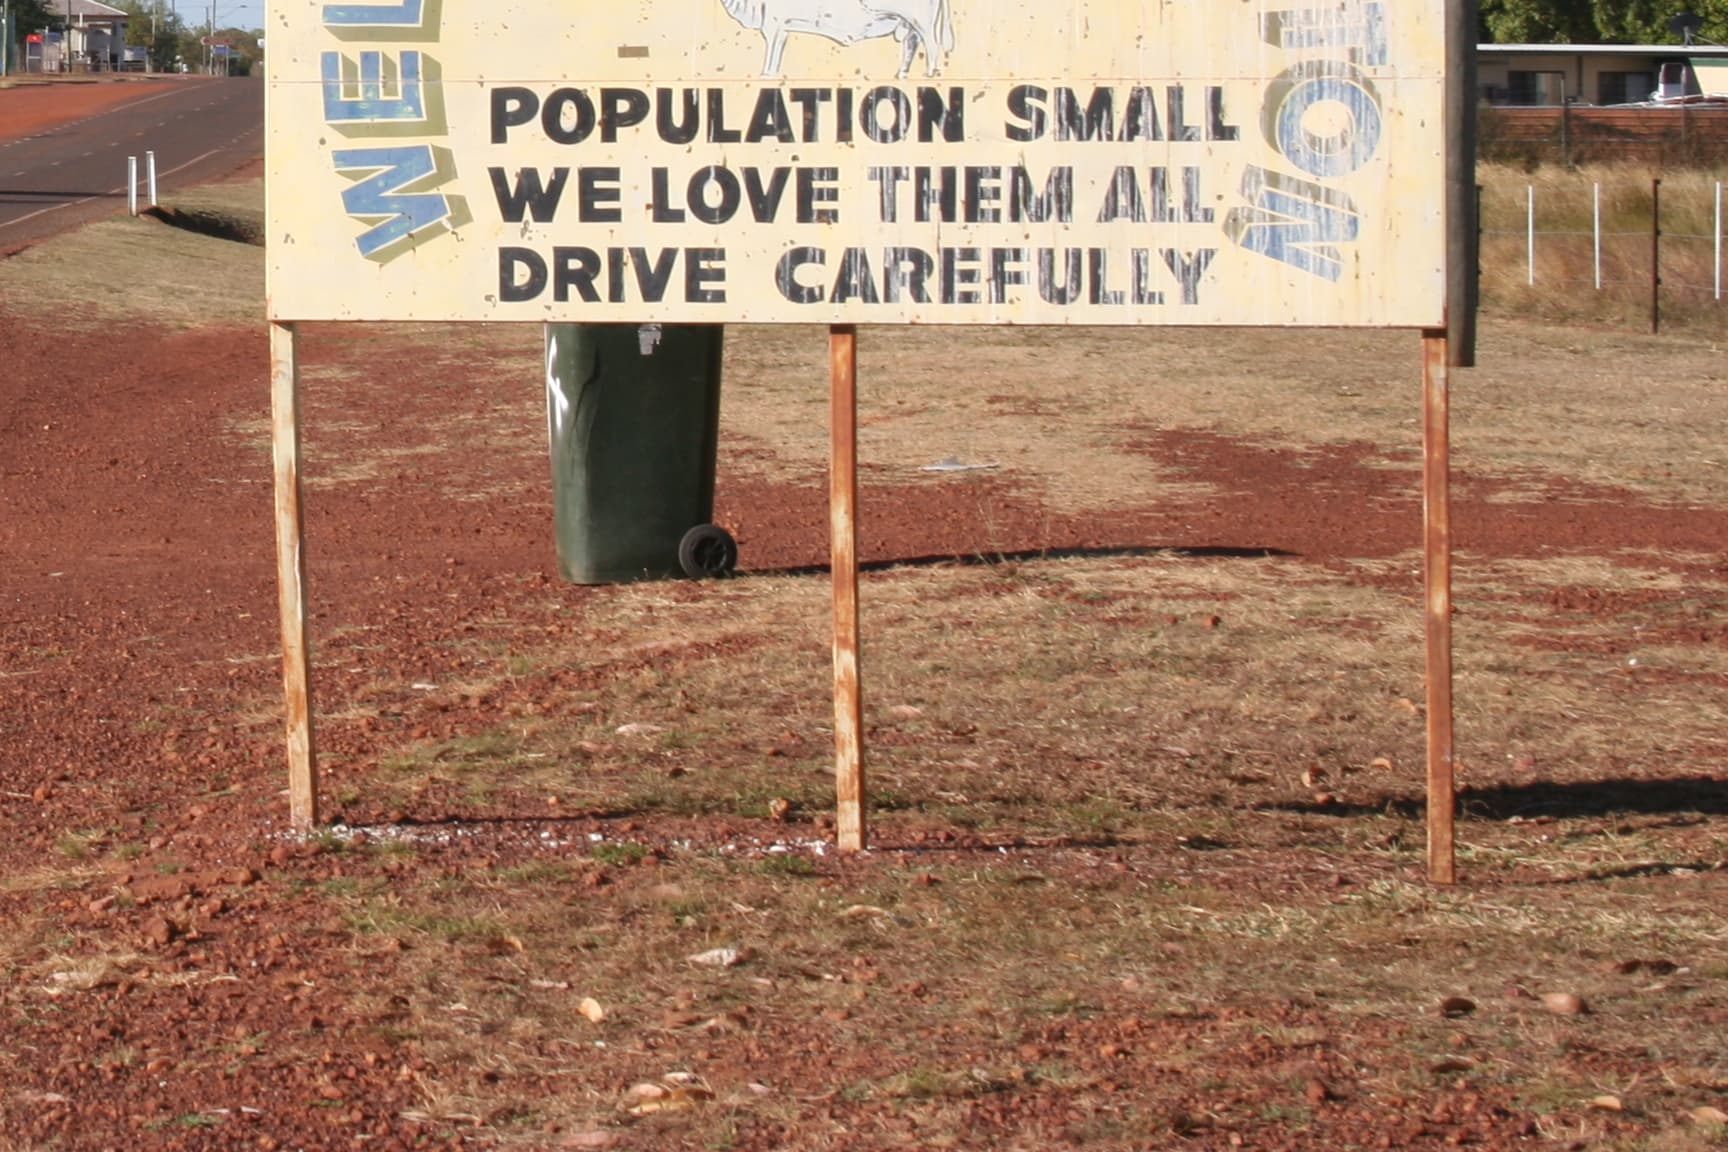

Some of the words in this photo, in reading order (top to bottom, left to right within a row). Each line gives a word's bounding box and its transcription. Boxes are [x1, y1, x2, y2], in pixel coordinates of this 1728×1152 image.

[490, 86, 965, 145] POPULATION
[1004, 85, 1240, 144] SMALL
[488, 166, 622, 224] WE
[651, 165, 840, 225] LOVE
[869, 165, 1074, 224] THEM
[1098, 165, 1215, 224] ALL
[498, 246, 727, 304] DRIVE
[774, 246, 1216, 306] CAREFULLY
